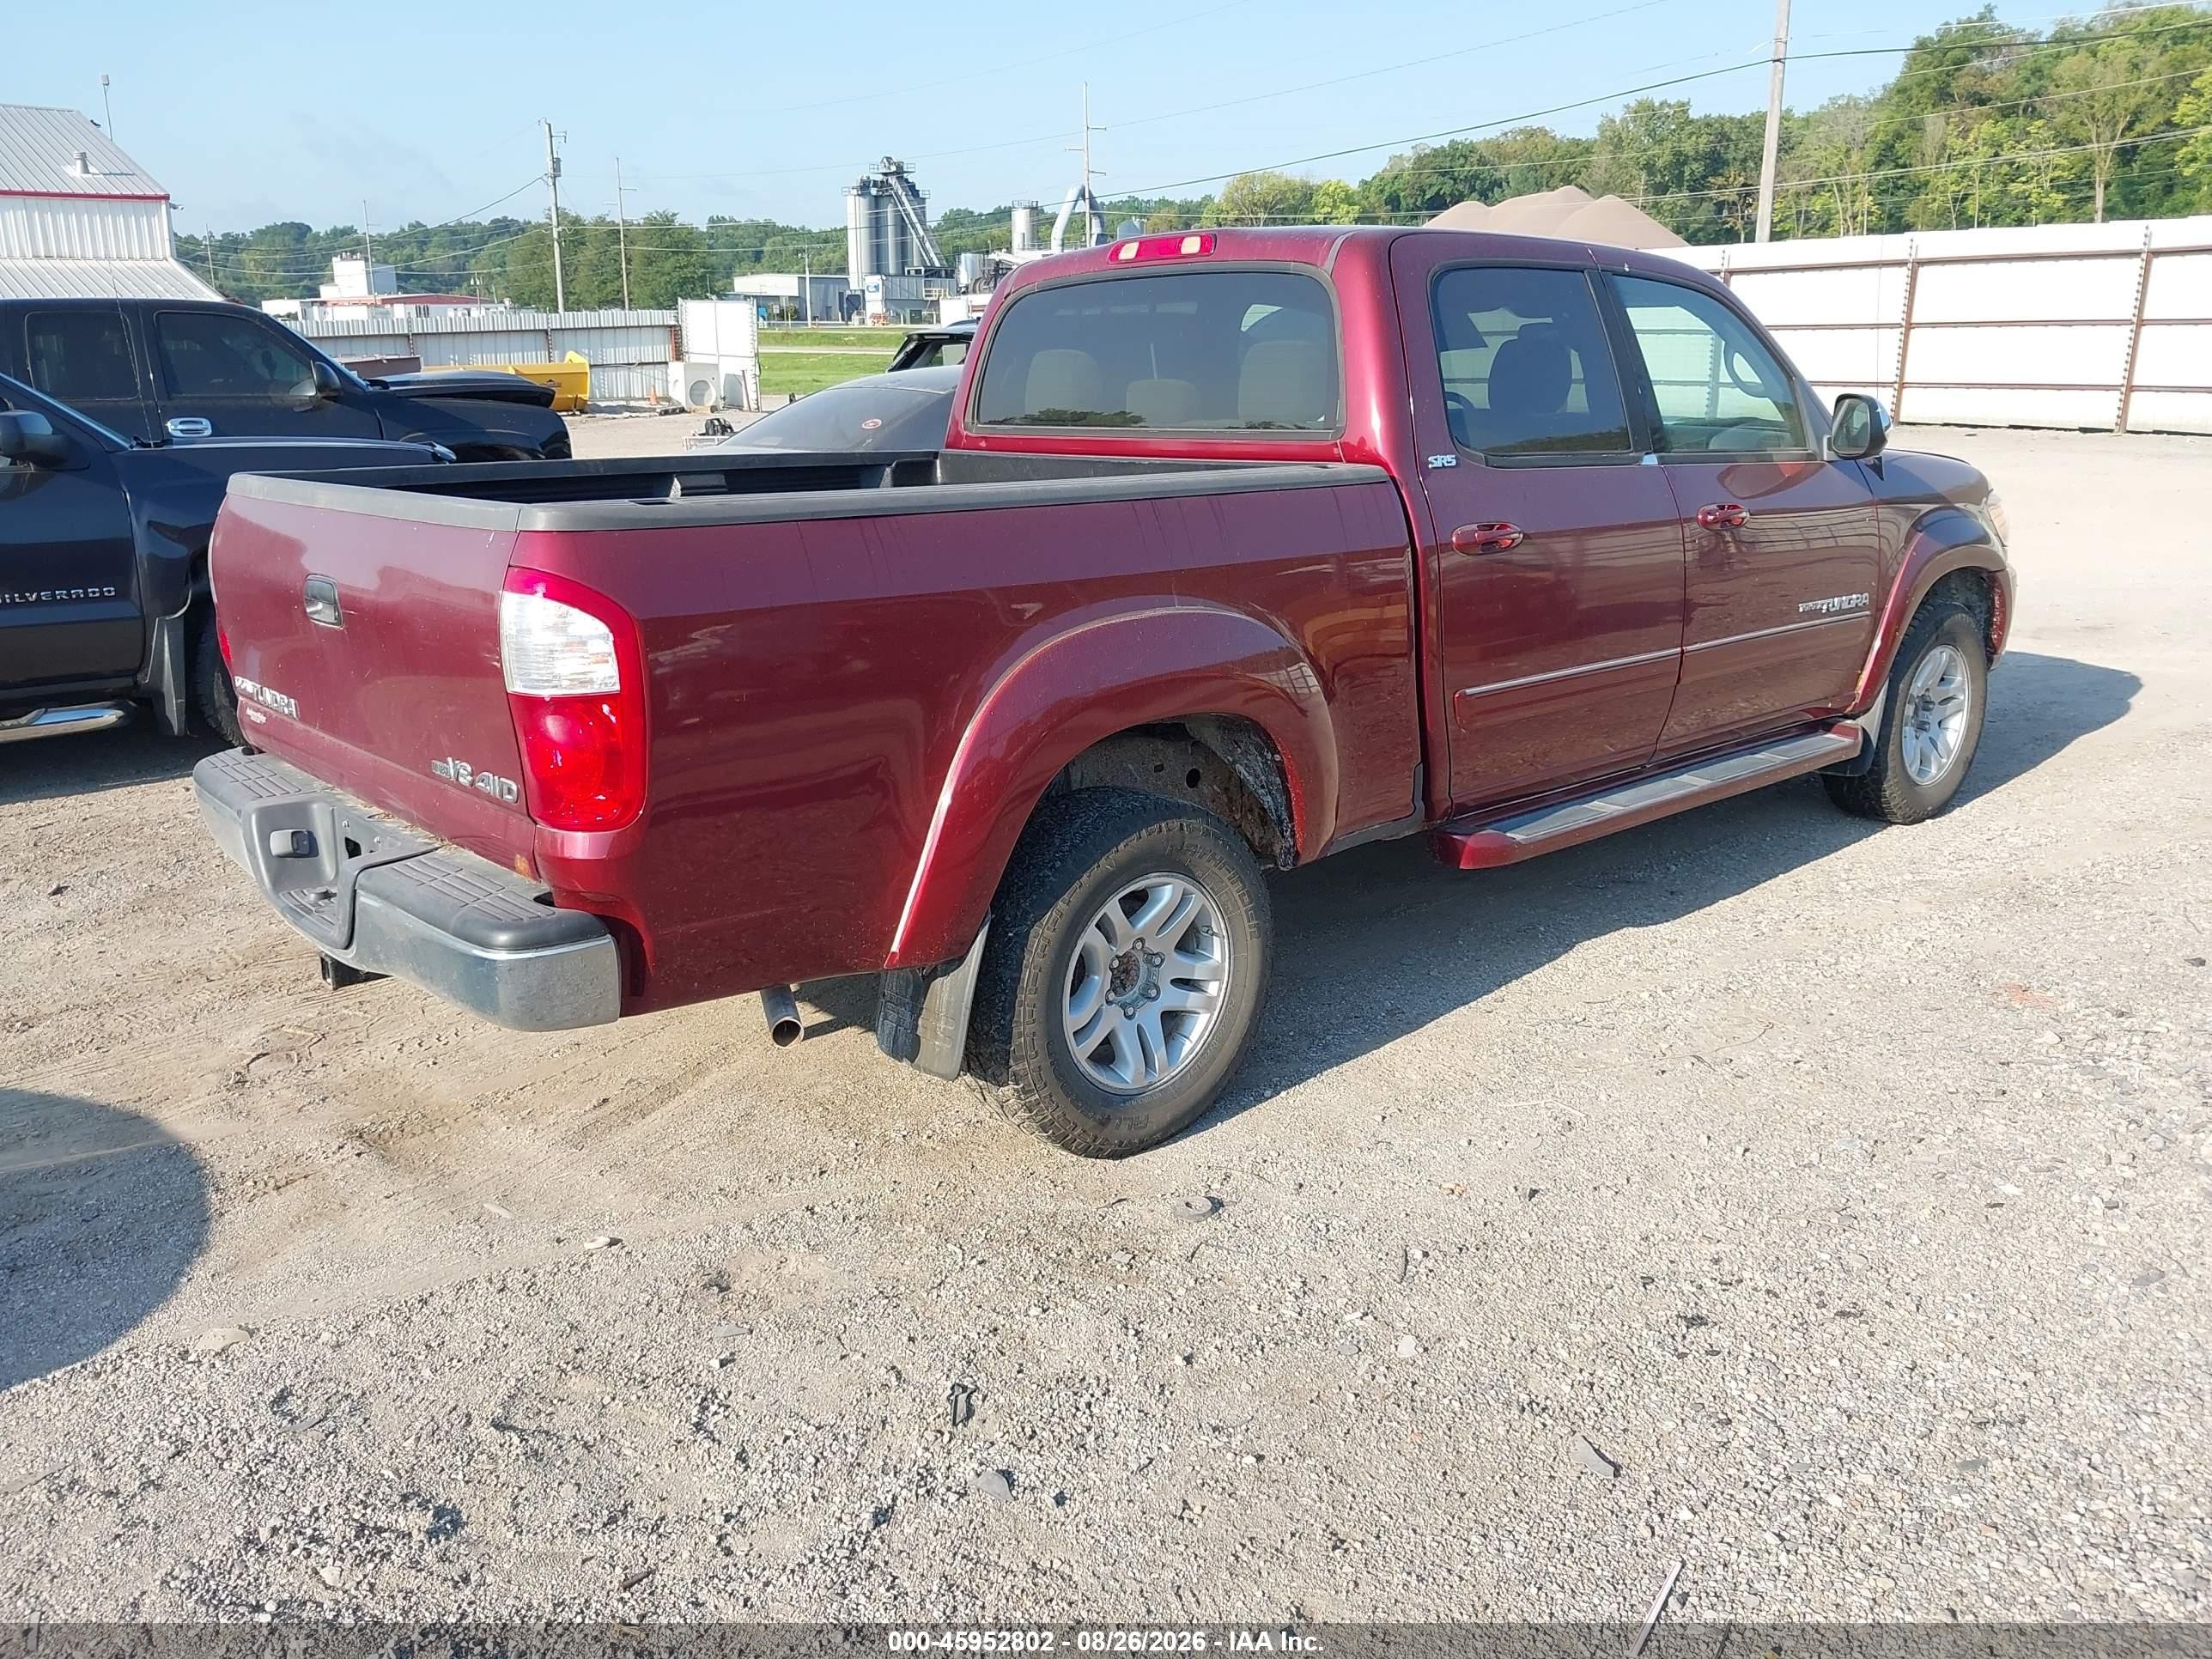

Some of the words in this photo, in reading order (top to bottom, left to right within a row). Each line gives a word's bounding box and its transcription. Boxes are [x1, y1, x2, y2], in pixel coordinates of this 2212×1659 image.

[1428, 454, 1456, 468] SR5
[0, 586, 116, 604] ILVERADO
[1820, 592, 1869, 613] TUNDRA
